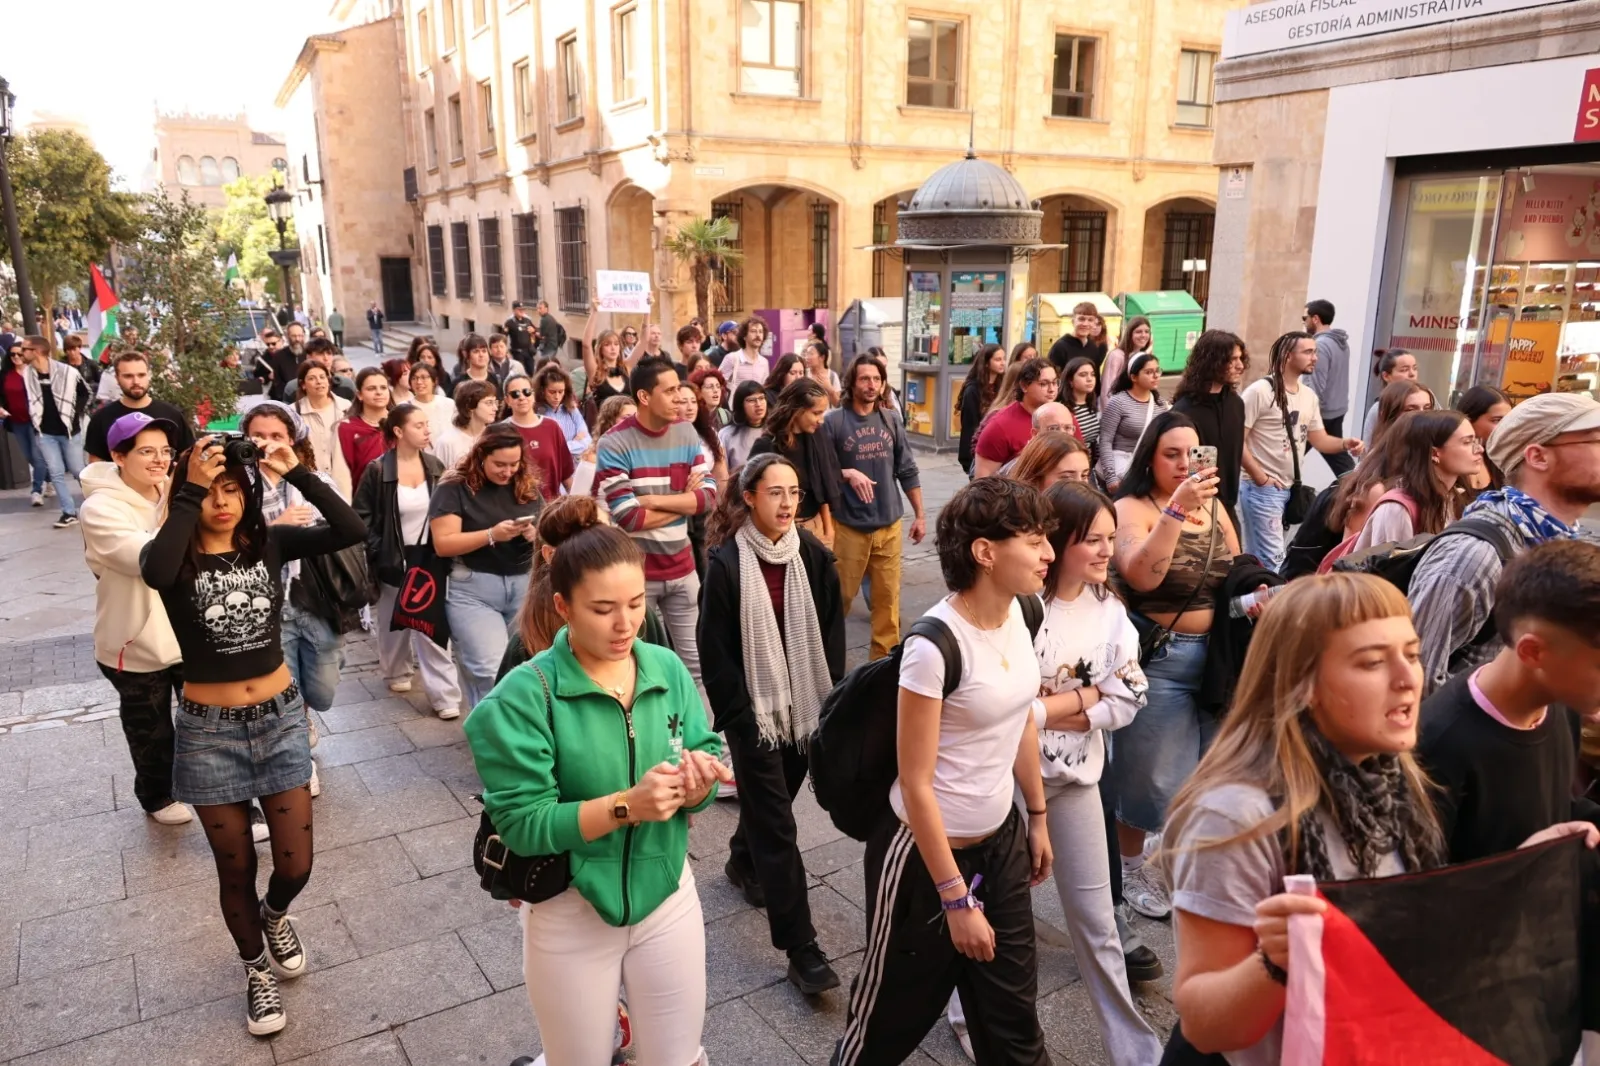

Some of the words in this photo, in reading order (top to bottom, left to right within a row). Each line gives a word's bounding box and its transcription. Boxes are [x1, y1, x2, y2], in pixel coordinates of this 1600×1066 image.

[1245, 0, 1305, 25] ASESORÍA
[1288, 14, 1351, 40] GESTORÍA
[1356, 0, 1482, 27] ADMINISTRATIVA
[1525, 199, 1545, 209] HELLO
[856, 427, 875, 438] BACK
[859, 442, 883, 453] SHAPE!
